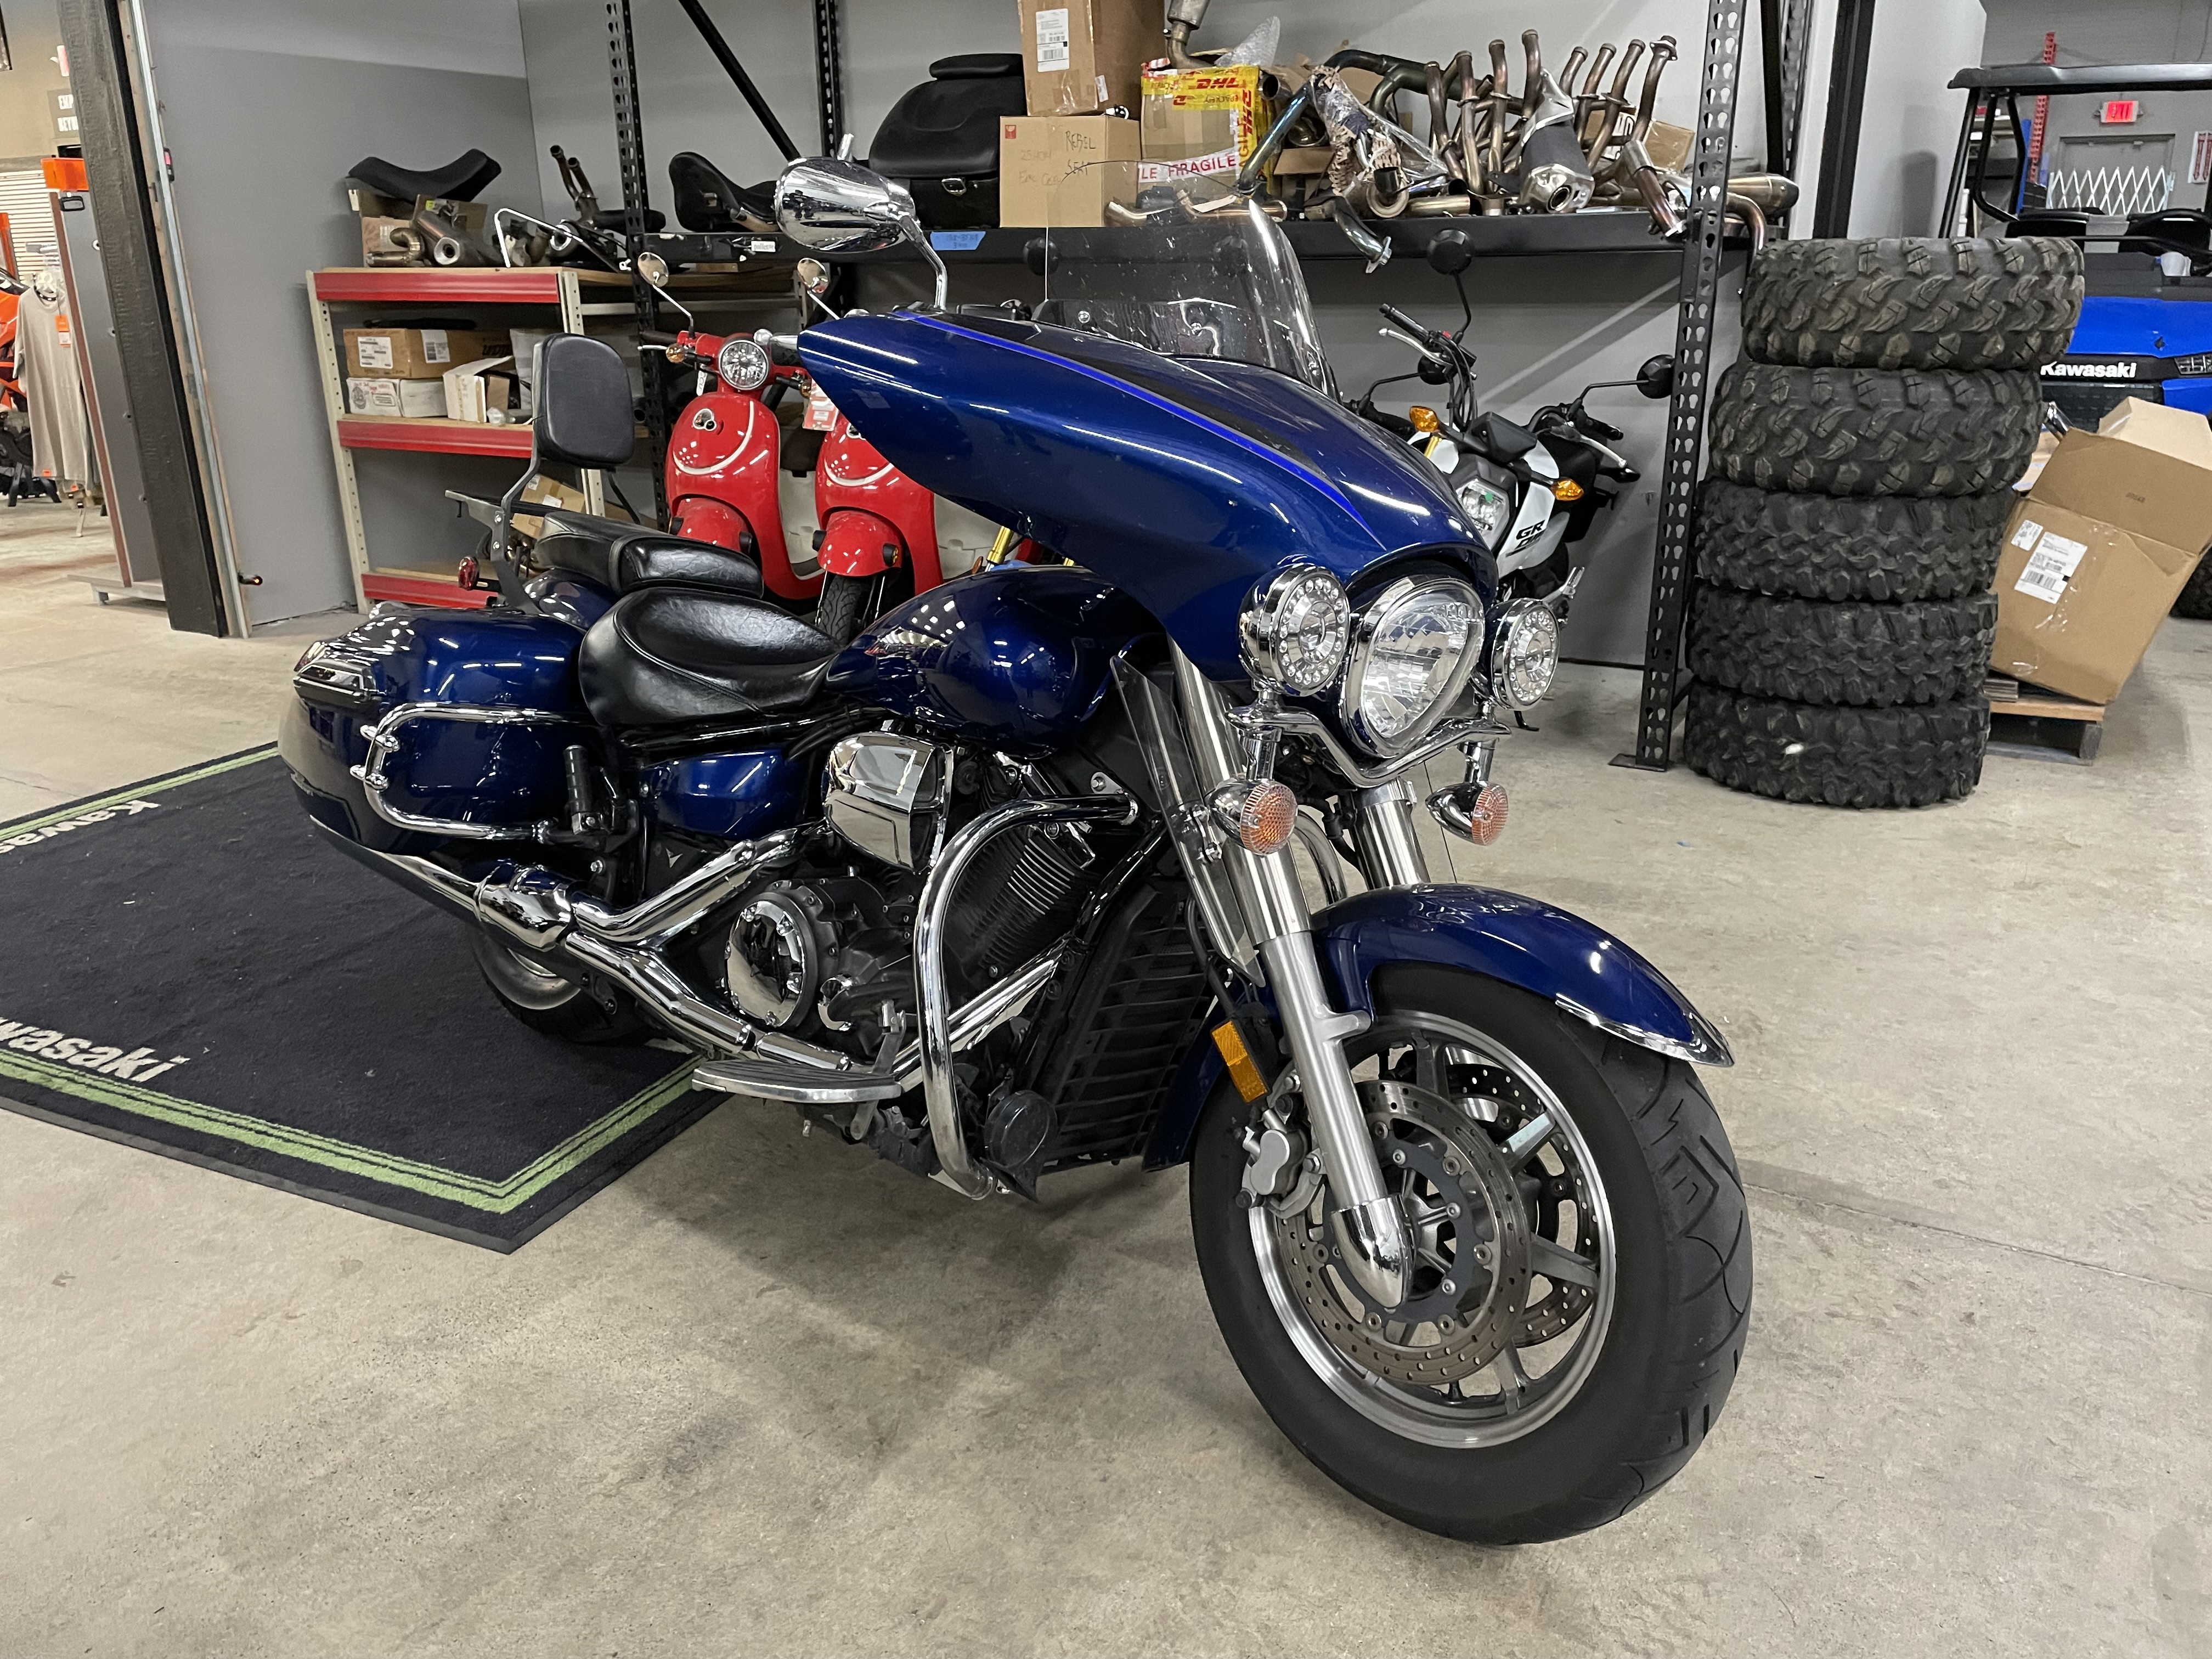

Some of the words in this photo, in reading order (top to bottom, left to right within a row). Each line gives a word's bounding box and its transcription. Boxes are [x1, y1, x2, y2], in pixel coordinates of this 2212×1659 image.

[1196, 78, 1239, 89] DHL
[1065, 130, 1096, 153] REBEL
[1139, 167, 1158, 179] LE
[1169, 155, 1237, 176] FRAGILE
[2040, 361, 2137, 378] Kawasaki
[1516, 520, 1545, 540] GR
